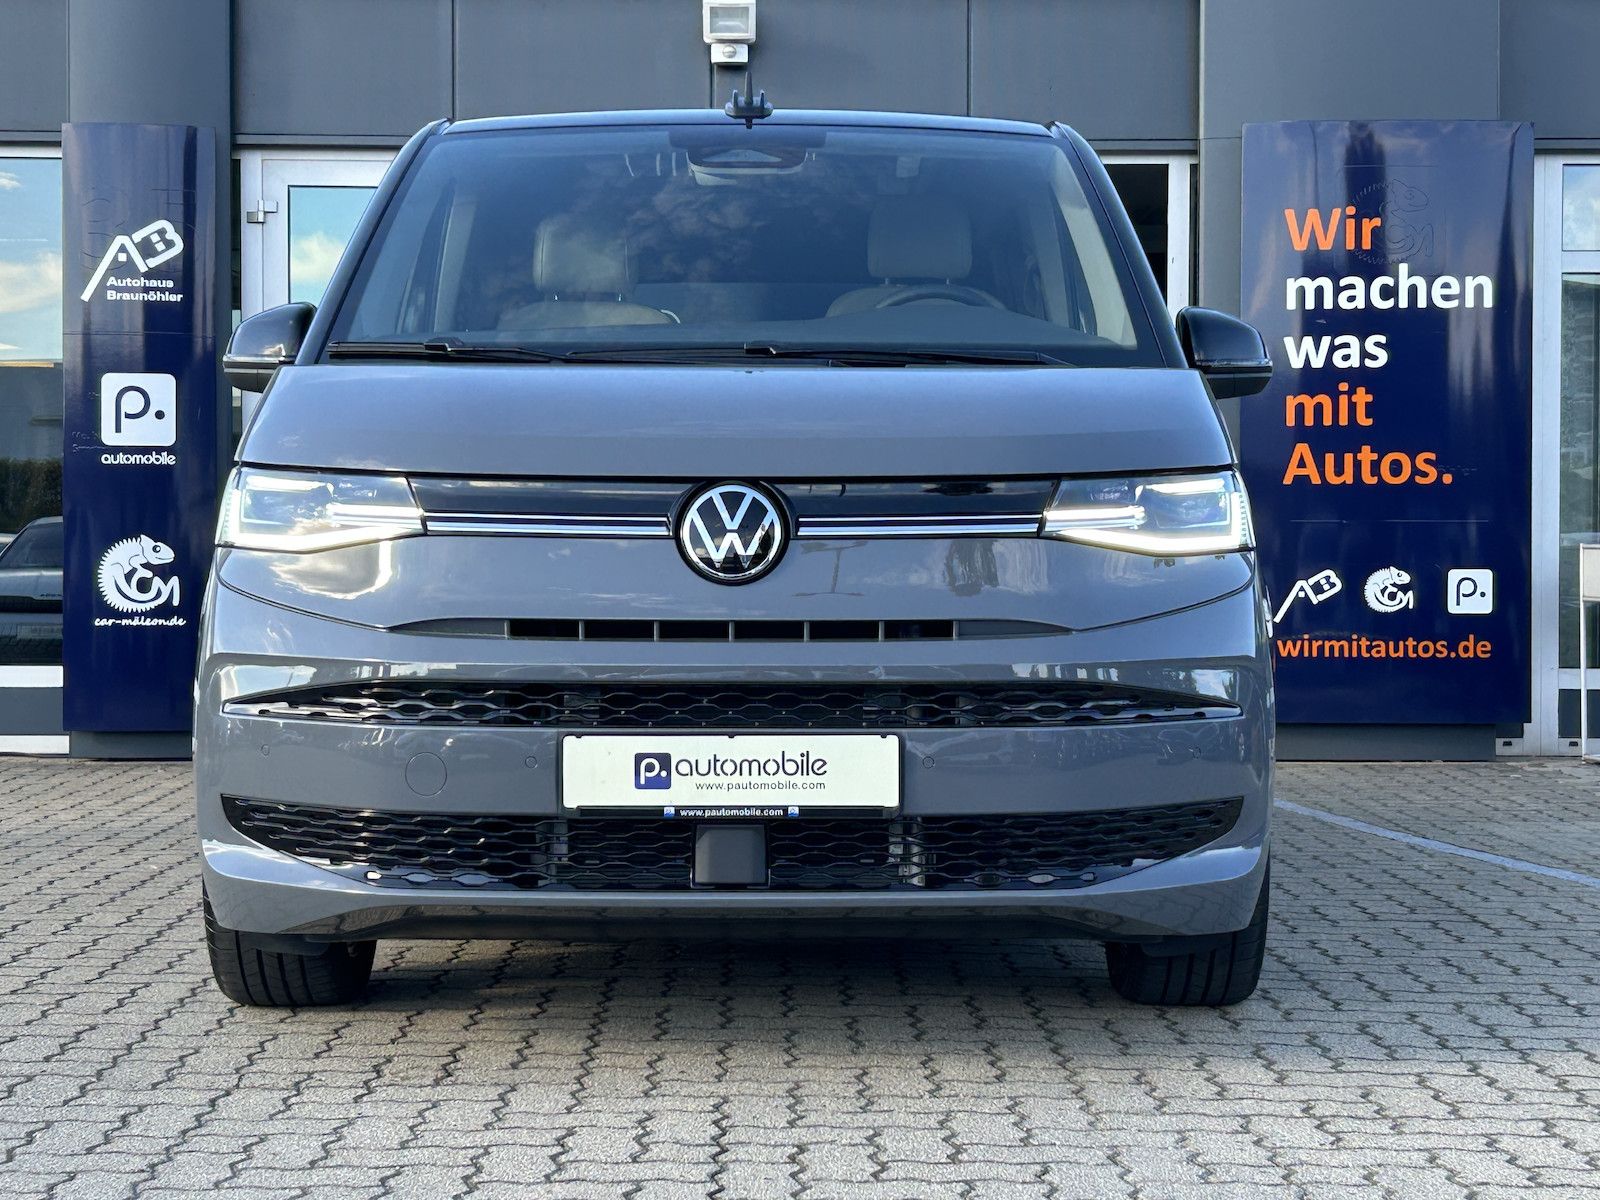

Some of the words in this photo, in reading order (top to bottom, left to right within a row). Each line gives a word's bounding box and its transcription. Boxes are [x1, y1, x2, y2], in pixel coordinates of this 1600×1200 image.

[1284, 205, 1382, 251] Wir
[106, 276, 174, 288] Autohaus
[1285, 262, 1494, 310] machen
[106, 290, 183, 302] Braunöhler
[1283, 333, 1389, 369] was
[1285, 382, 1374, 427] mit
[100, 451, 176, 465] automobile
[1282, 442, 1453, 486] Autos.
[682, 484, 782, 580] VW
[1276, 633, 1493, 659] wirmitautos.de
[675, 750, 828, 777] automobile
[695, 780, 826, 792] www.pautomobile.com
[680, 807, 784, 818] www.pautomobile.com
